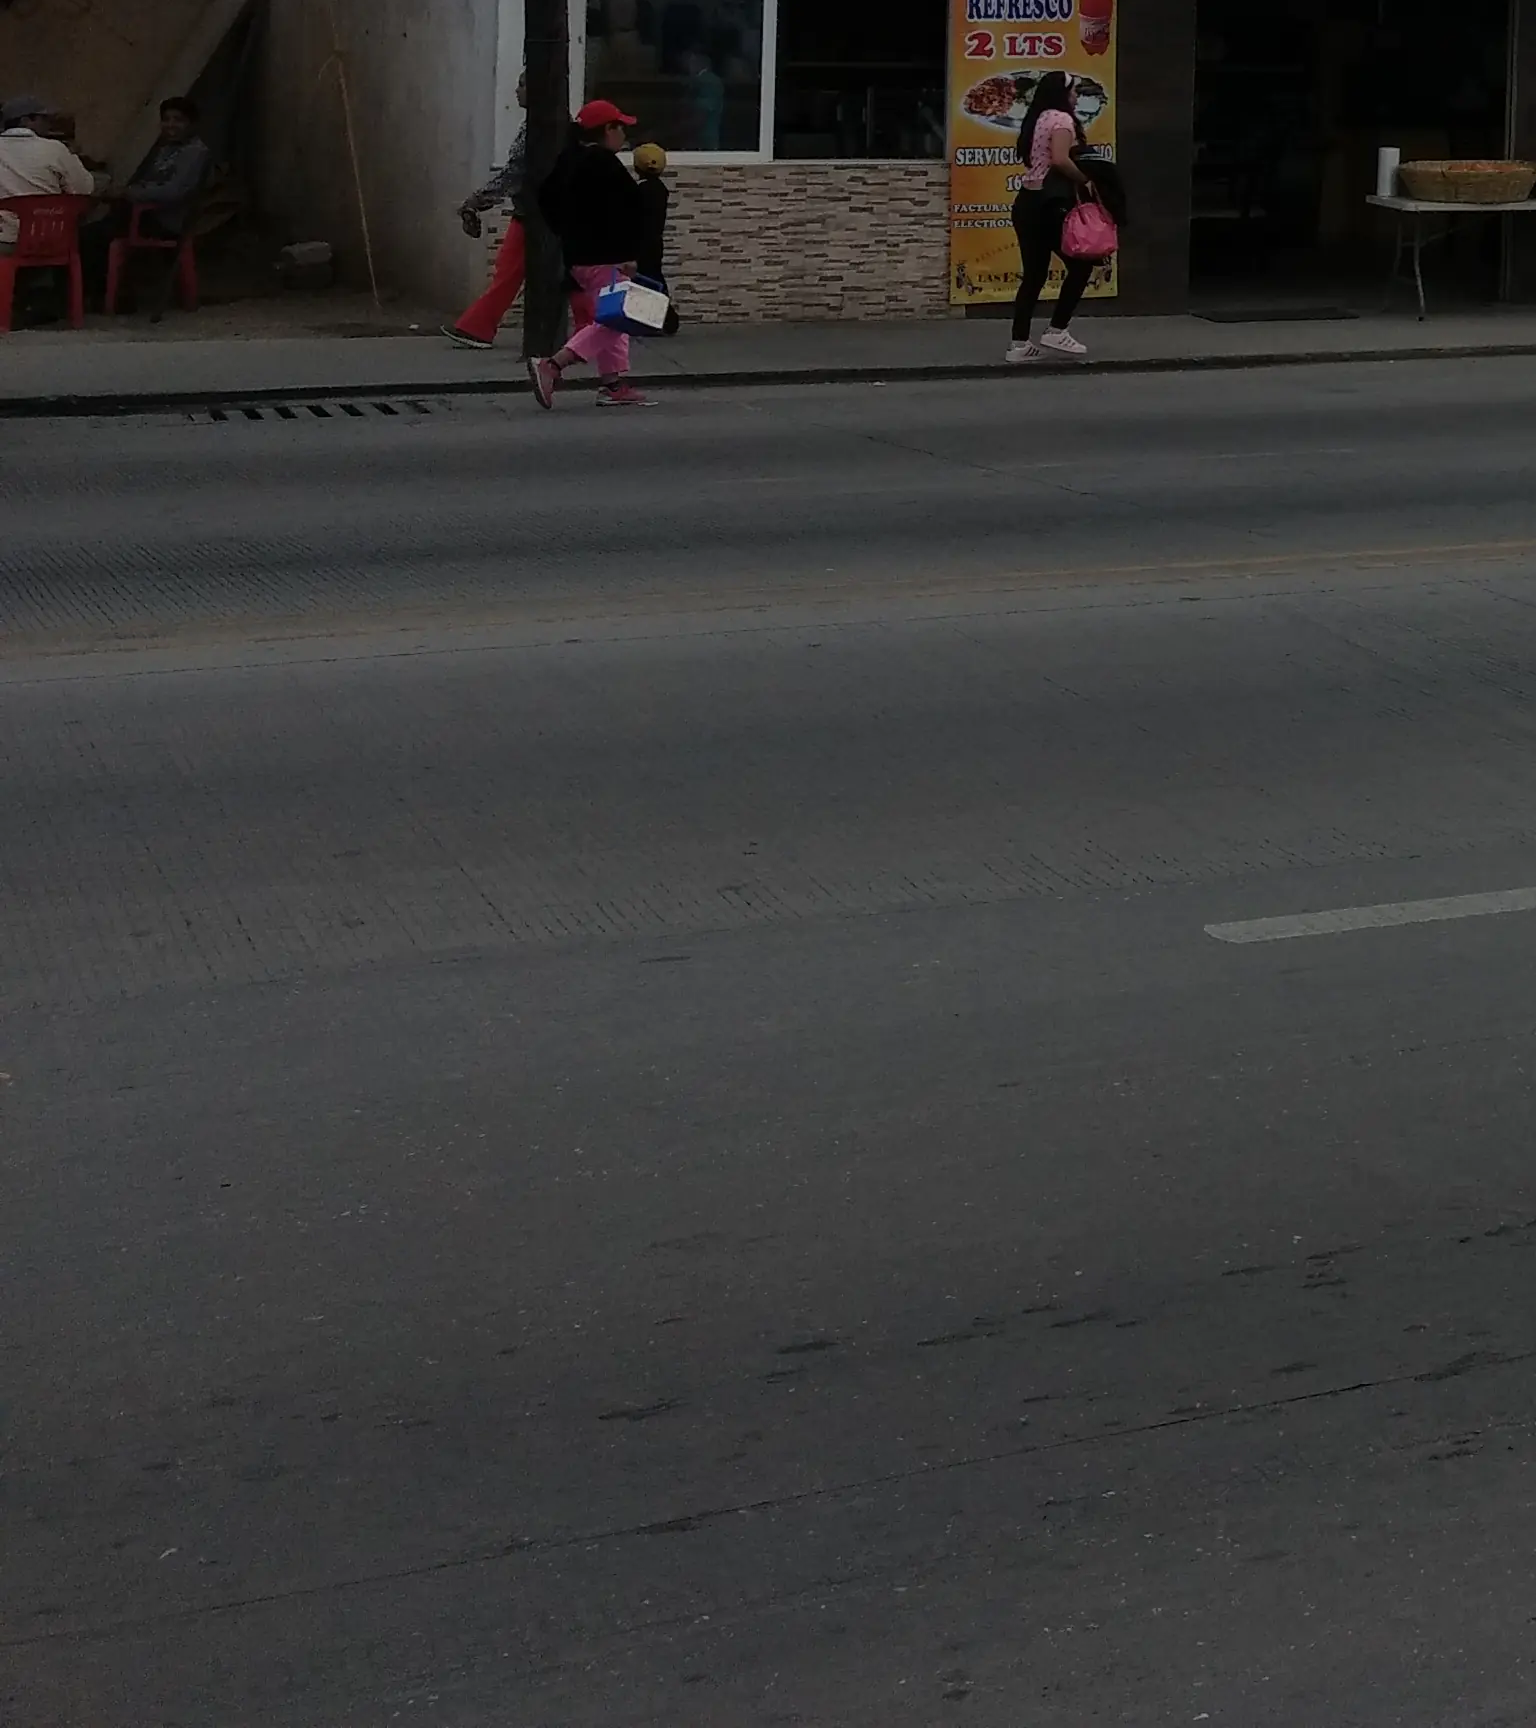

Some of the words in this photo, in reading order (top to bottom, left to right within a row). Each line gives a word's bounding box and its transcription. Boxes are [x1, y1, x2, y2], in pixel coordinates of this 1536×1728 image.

[966, 32, 995, 58] 2
[1005, 35, 1064, 57] LTS
[954, 203, 1015, 214] FACTURAC
[954, 219, 1014, 229] ELECTRON
